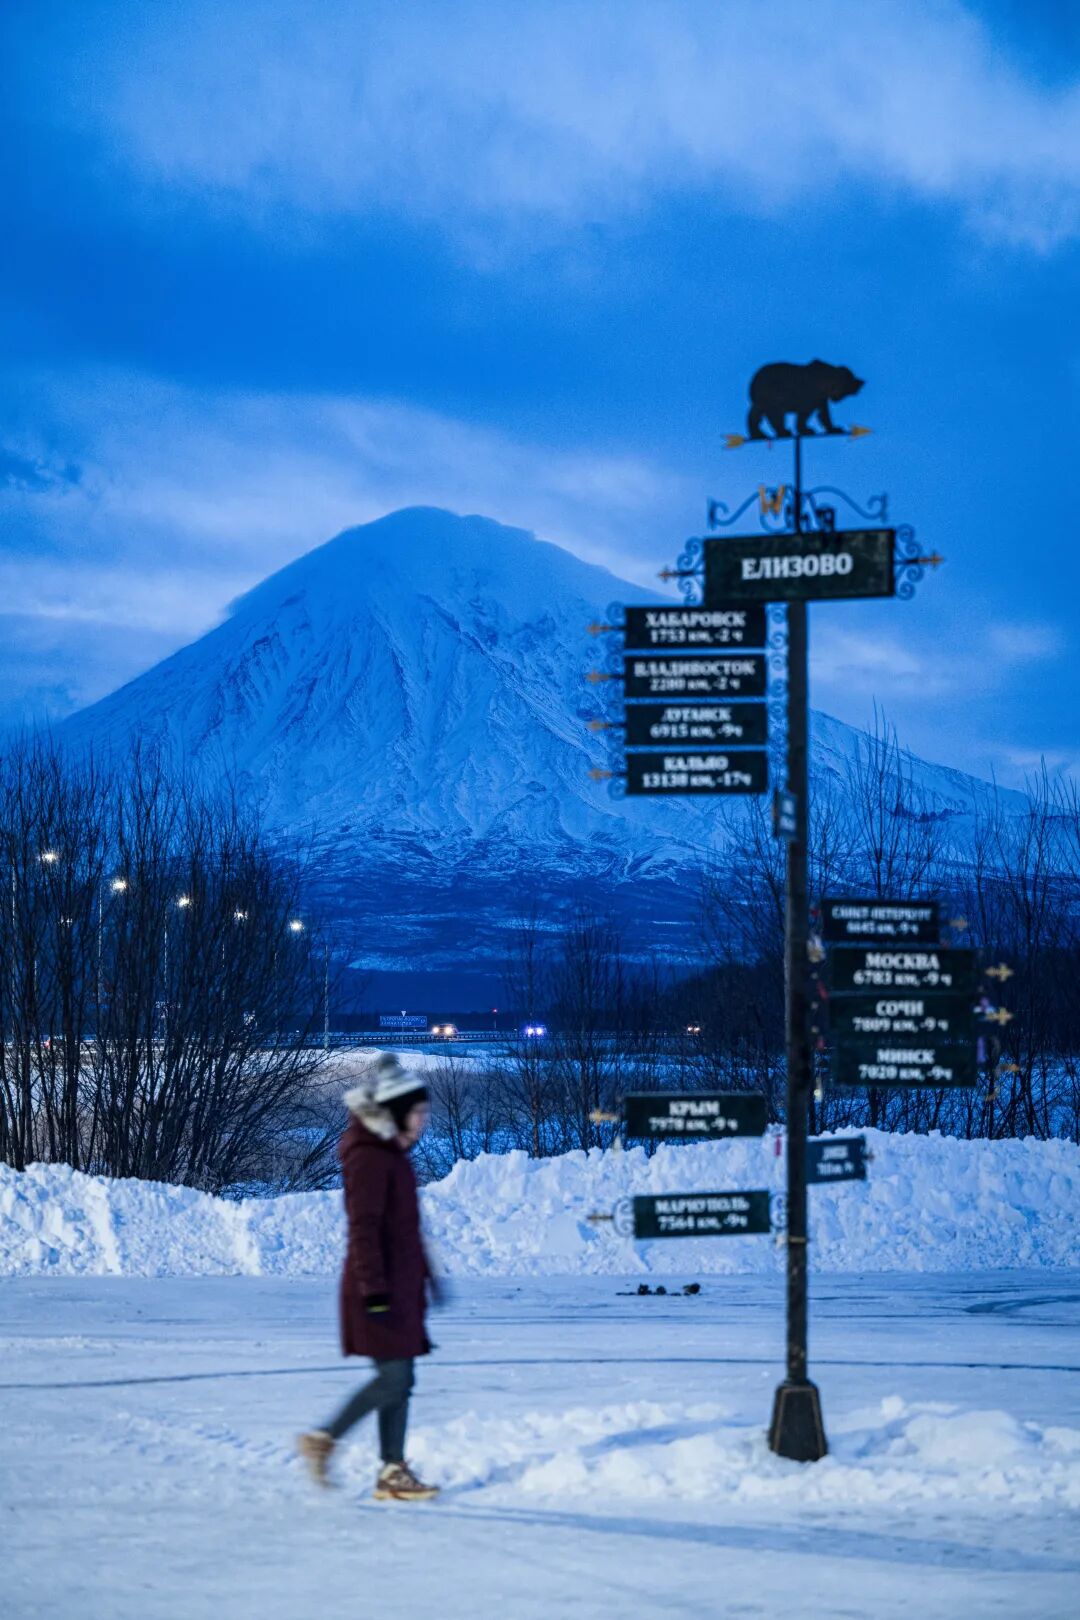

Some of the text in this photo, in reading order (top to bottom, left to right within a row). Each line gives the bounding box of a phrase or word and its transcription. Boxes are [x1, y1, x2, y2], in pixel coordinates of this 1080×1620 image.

[742, 552, 853, 580] ЕЛИЗОВО
[645, 611, 746, 628] ХАБАРОВСК
[634, 660, 756, 677] ВЛАДИВОСТОК
[661, 707, 732, 722] ЛУГАНСК
[865, 952, 940, 970] МОСКВА
[875, 1001, 924, 1017] СОЧИ
[876, 1049, 936, 1064] МИНСК
[669, 1100, 720, 1117] КРЫМ
[655, 1197, 750, 1215] МАРИУПОЛЬ
